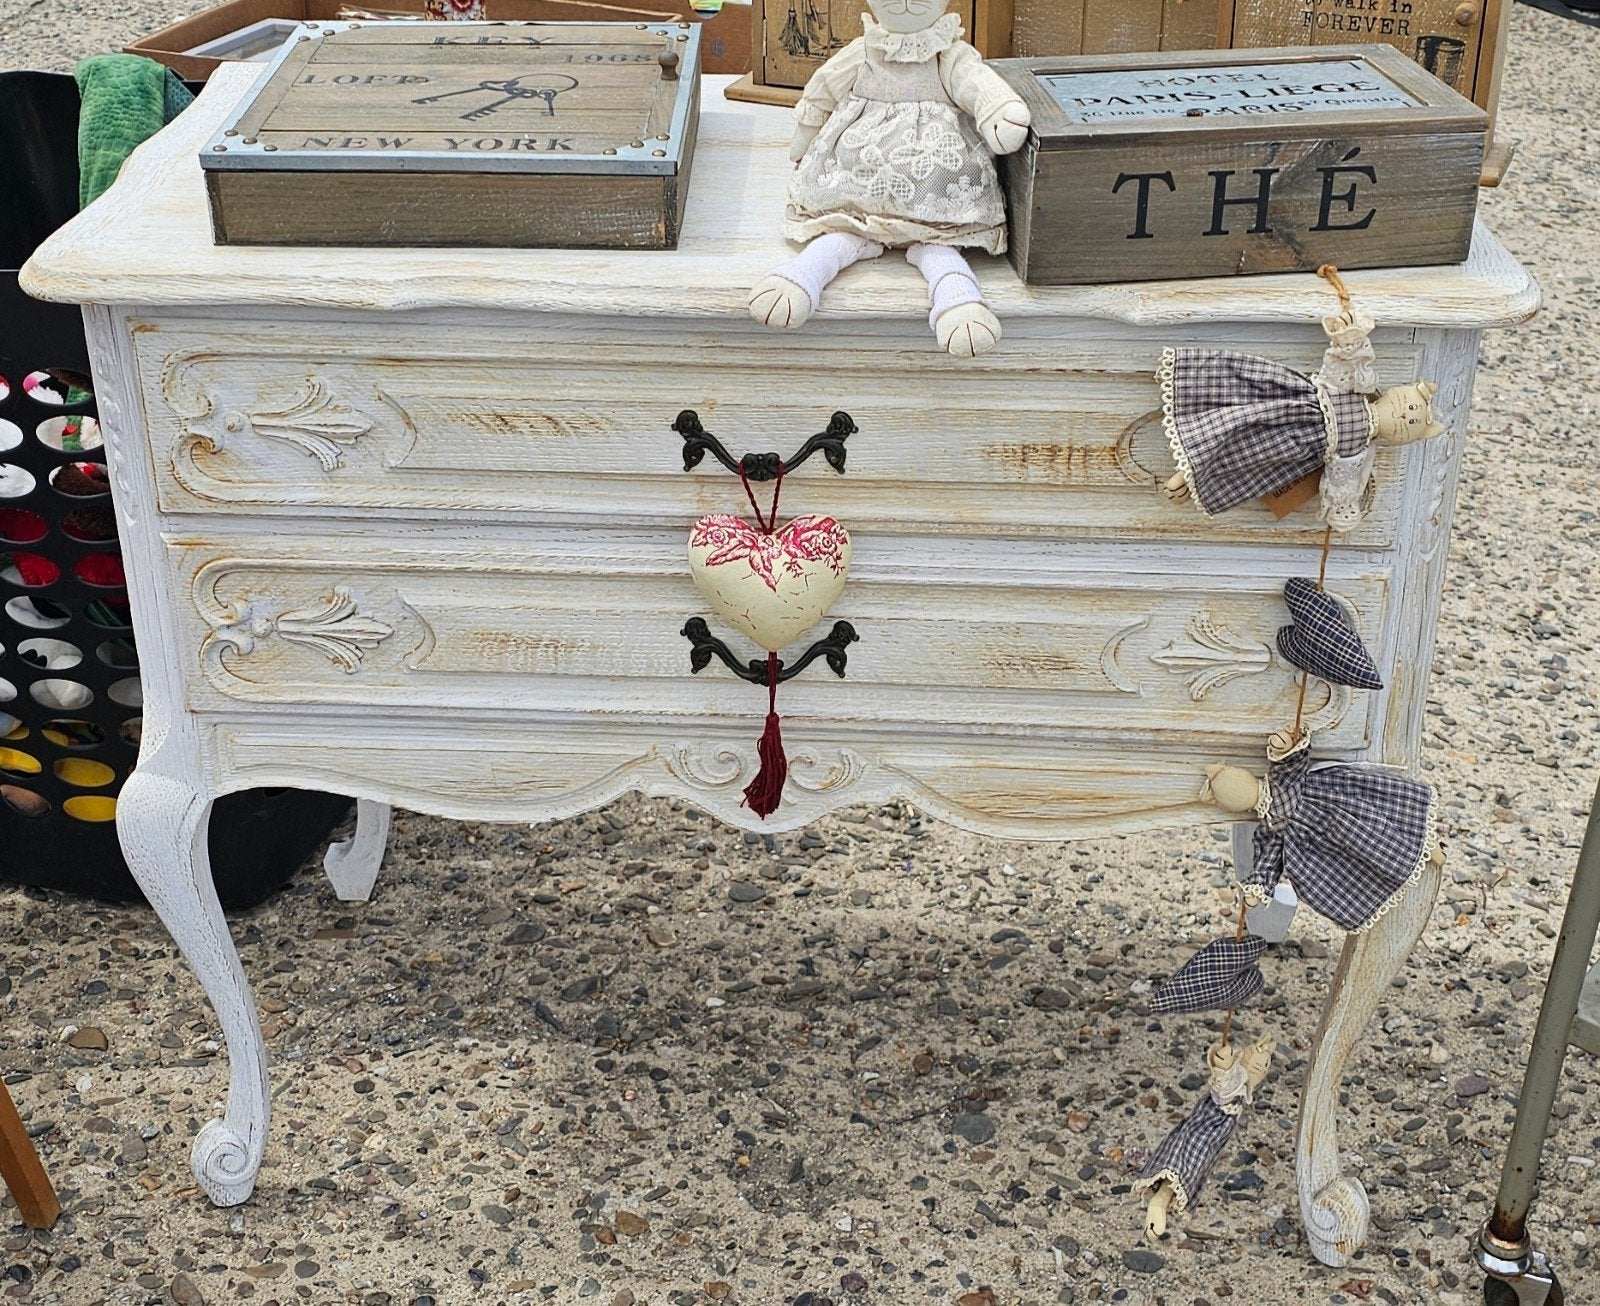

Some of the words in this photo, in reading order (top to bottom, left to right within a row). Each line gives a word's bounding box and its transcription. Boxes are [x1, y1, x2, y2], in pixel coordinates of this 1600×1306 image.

[1334, 0, 1378, 11] walk
[1389, 0, 1412, 13] in
[1300, 10, 1410, 36] FOREVER
[429, 36, 554, 49] KEY
[562, 53, 652, 63] 1968
[1137, 73, 1280, 88] HOTEL
[301, 137, 415, 149] NEW
[443, 137, 577, 151] YORK
[1112, 146, 1378, 239] THÉ
